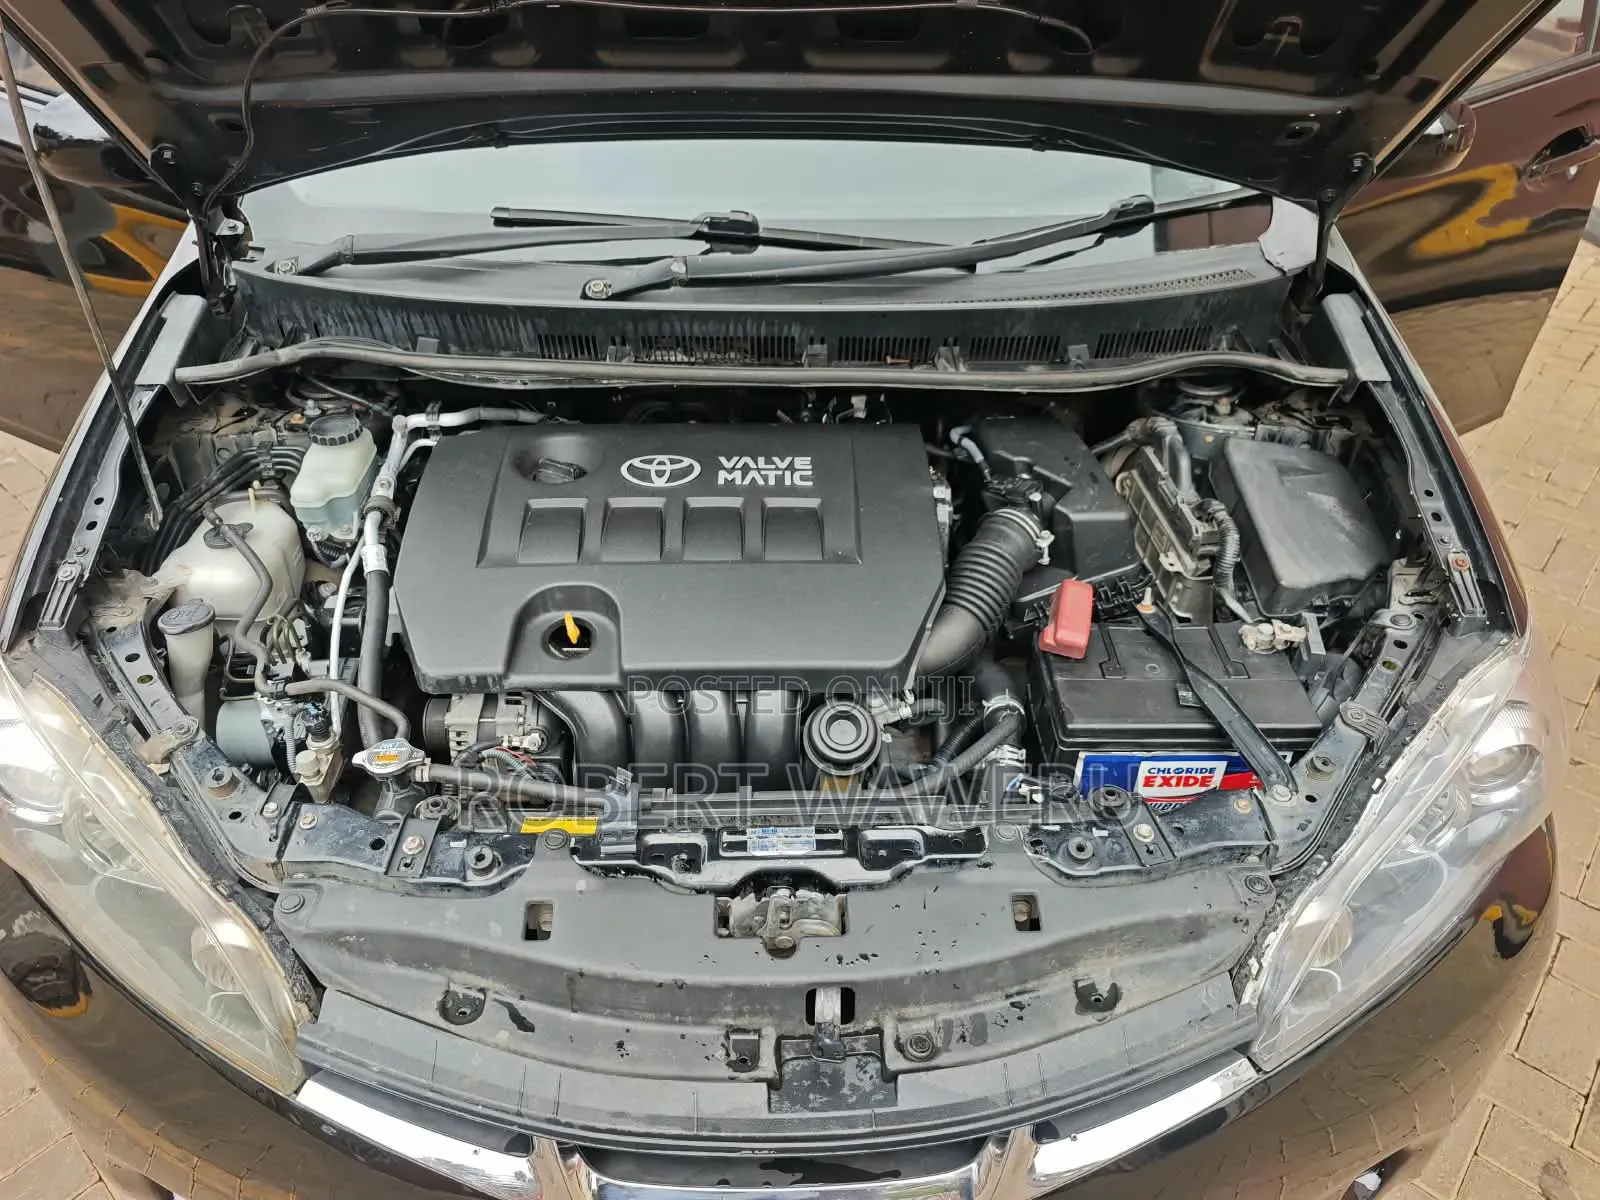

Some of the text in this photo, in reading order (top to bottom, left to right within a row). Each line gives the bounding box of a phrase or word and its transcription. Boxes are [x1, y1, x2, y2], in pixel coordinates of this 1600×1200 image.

[718, 456, 812, 468] VALVE
[718, 470, 813, 485] MATIC
[1142, 775, 1215, 787] EXIDE
